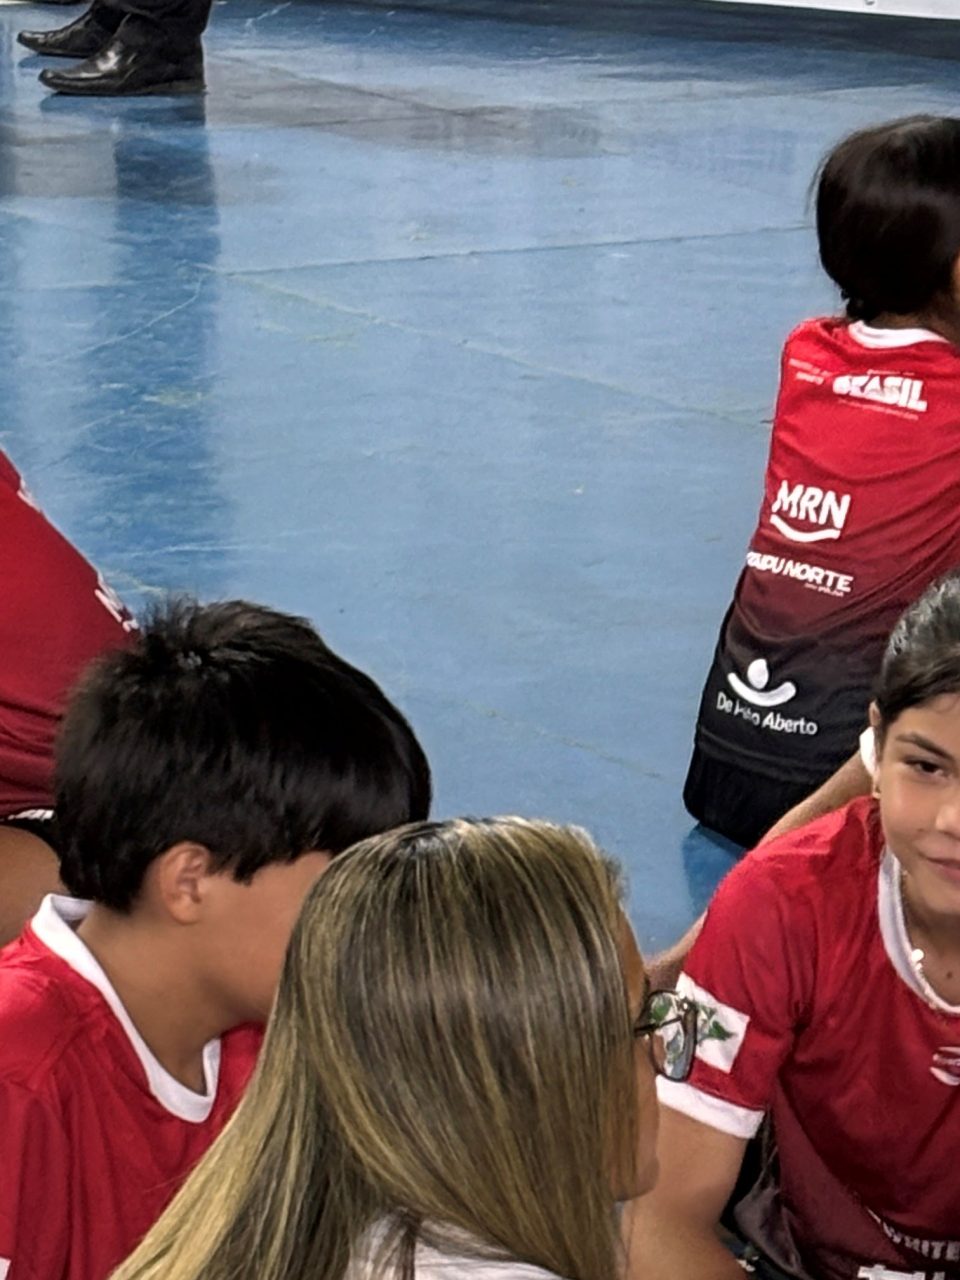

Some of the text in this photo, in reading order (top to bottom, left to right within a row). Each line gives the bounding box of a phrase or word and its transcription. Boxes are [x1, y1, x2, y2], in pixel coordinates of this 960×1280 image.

[771, 480, 851, 529] MRN
[783, 559, 854, 593] NORTE
[761, 711, 818, 735] Aberto
